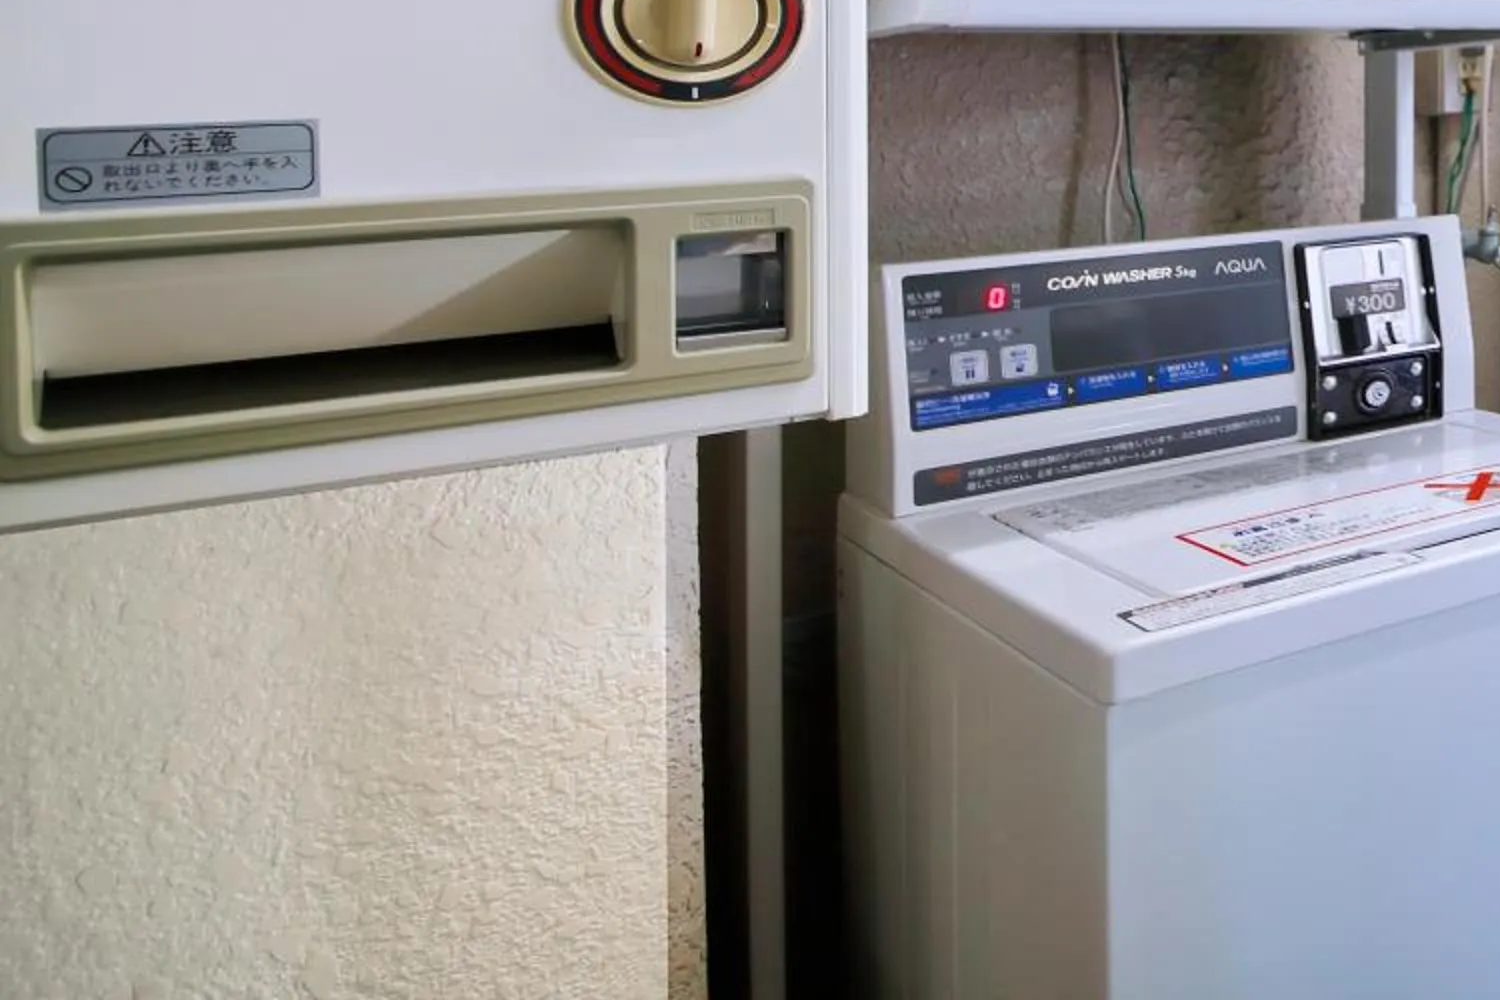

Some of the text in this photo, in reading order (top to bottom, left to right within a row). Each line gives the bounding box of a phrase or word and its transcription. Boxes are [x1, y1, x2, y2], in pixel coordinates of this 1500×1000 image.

[169, 130, 241, 154] 注意
[1103, 266, 1173, 285] WASHER
[1174, 264, 1197, 279] 5kg
[1214, 257, 1267, 276] AQUA
[987, 286, 1007, 309] 0
[1345, 292, 1396, 316] ¥300
